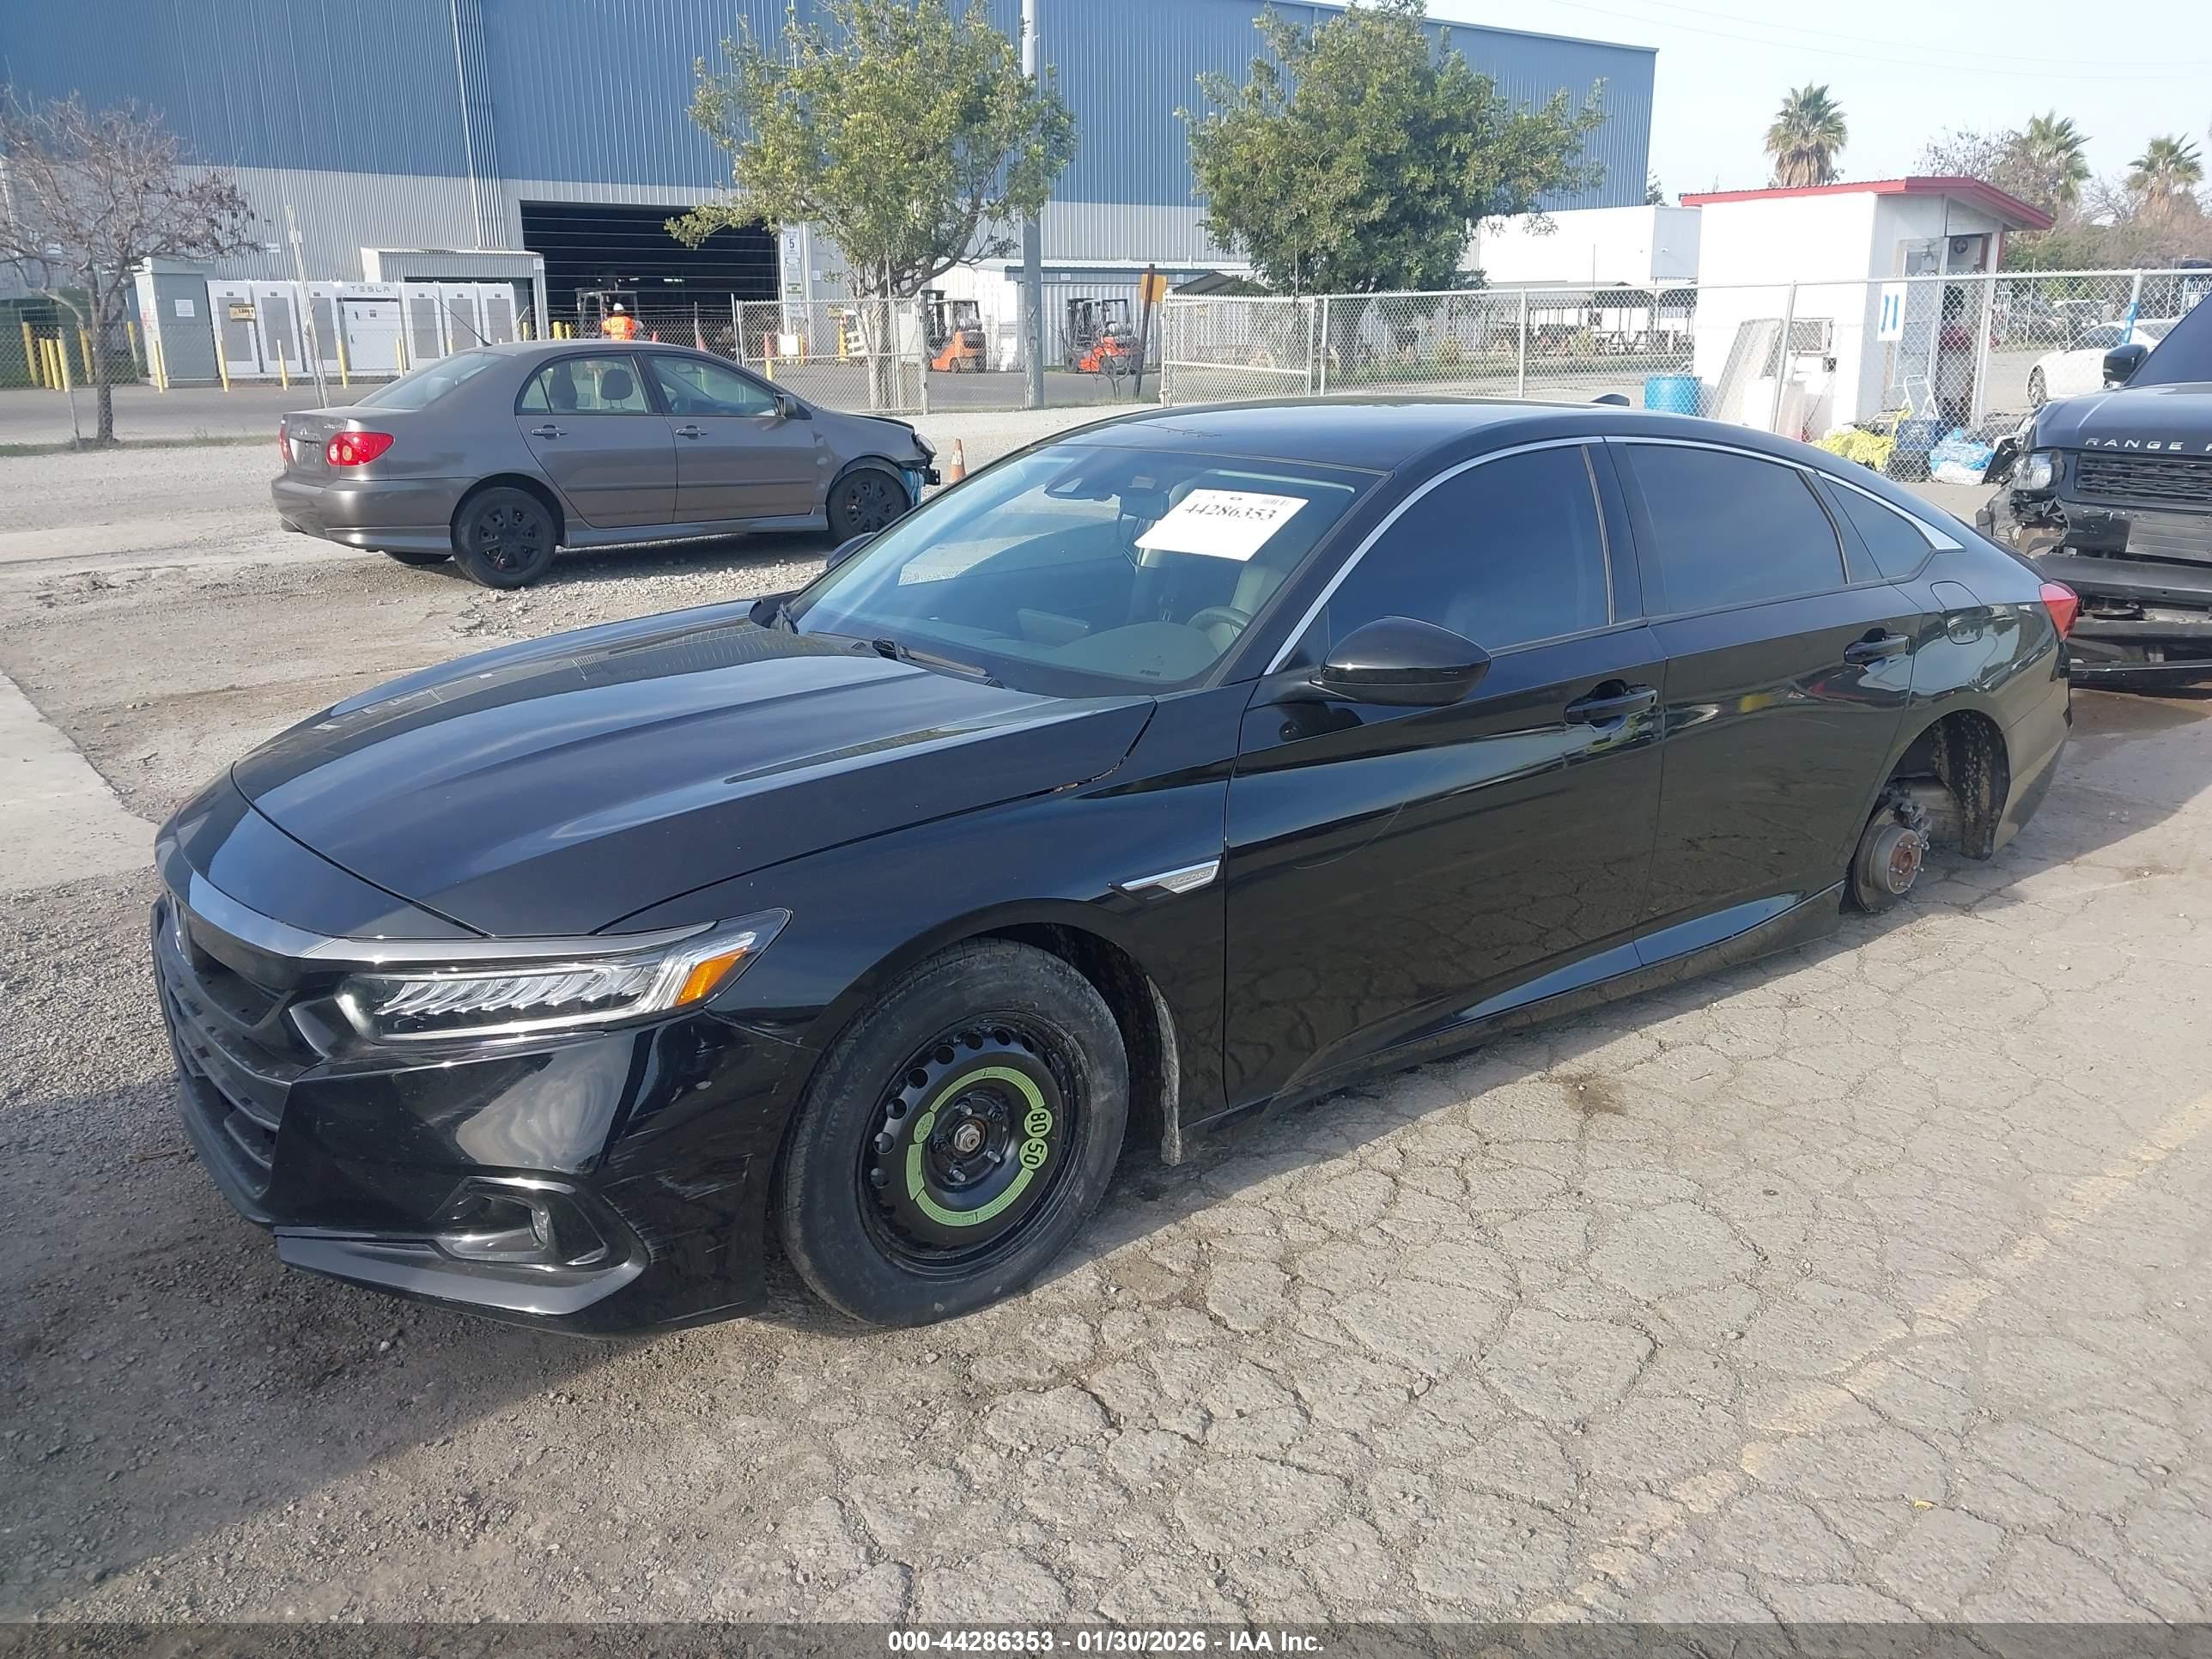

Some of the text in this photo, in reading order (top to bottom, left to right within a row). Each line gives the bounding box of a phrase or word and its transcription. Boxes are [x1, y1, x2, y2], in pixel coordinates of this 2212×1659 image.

[789, 238, 794, 249] 5
[2085, 437, 2185, 451] RANGE
[1184, 502, 1278, 520] 44286353
[1168, 869, 1212, 887] ACCORD
[1023, 1111, 1048, 1165] 80 50
